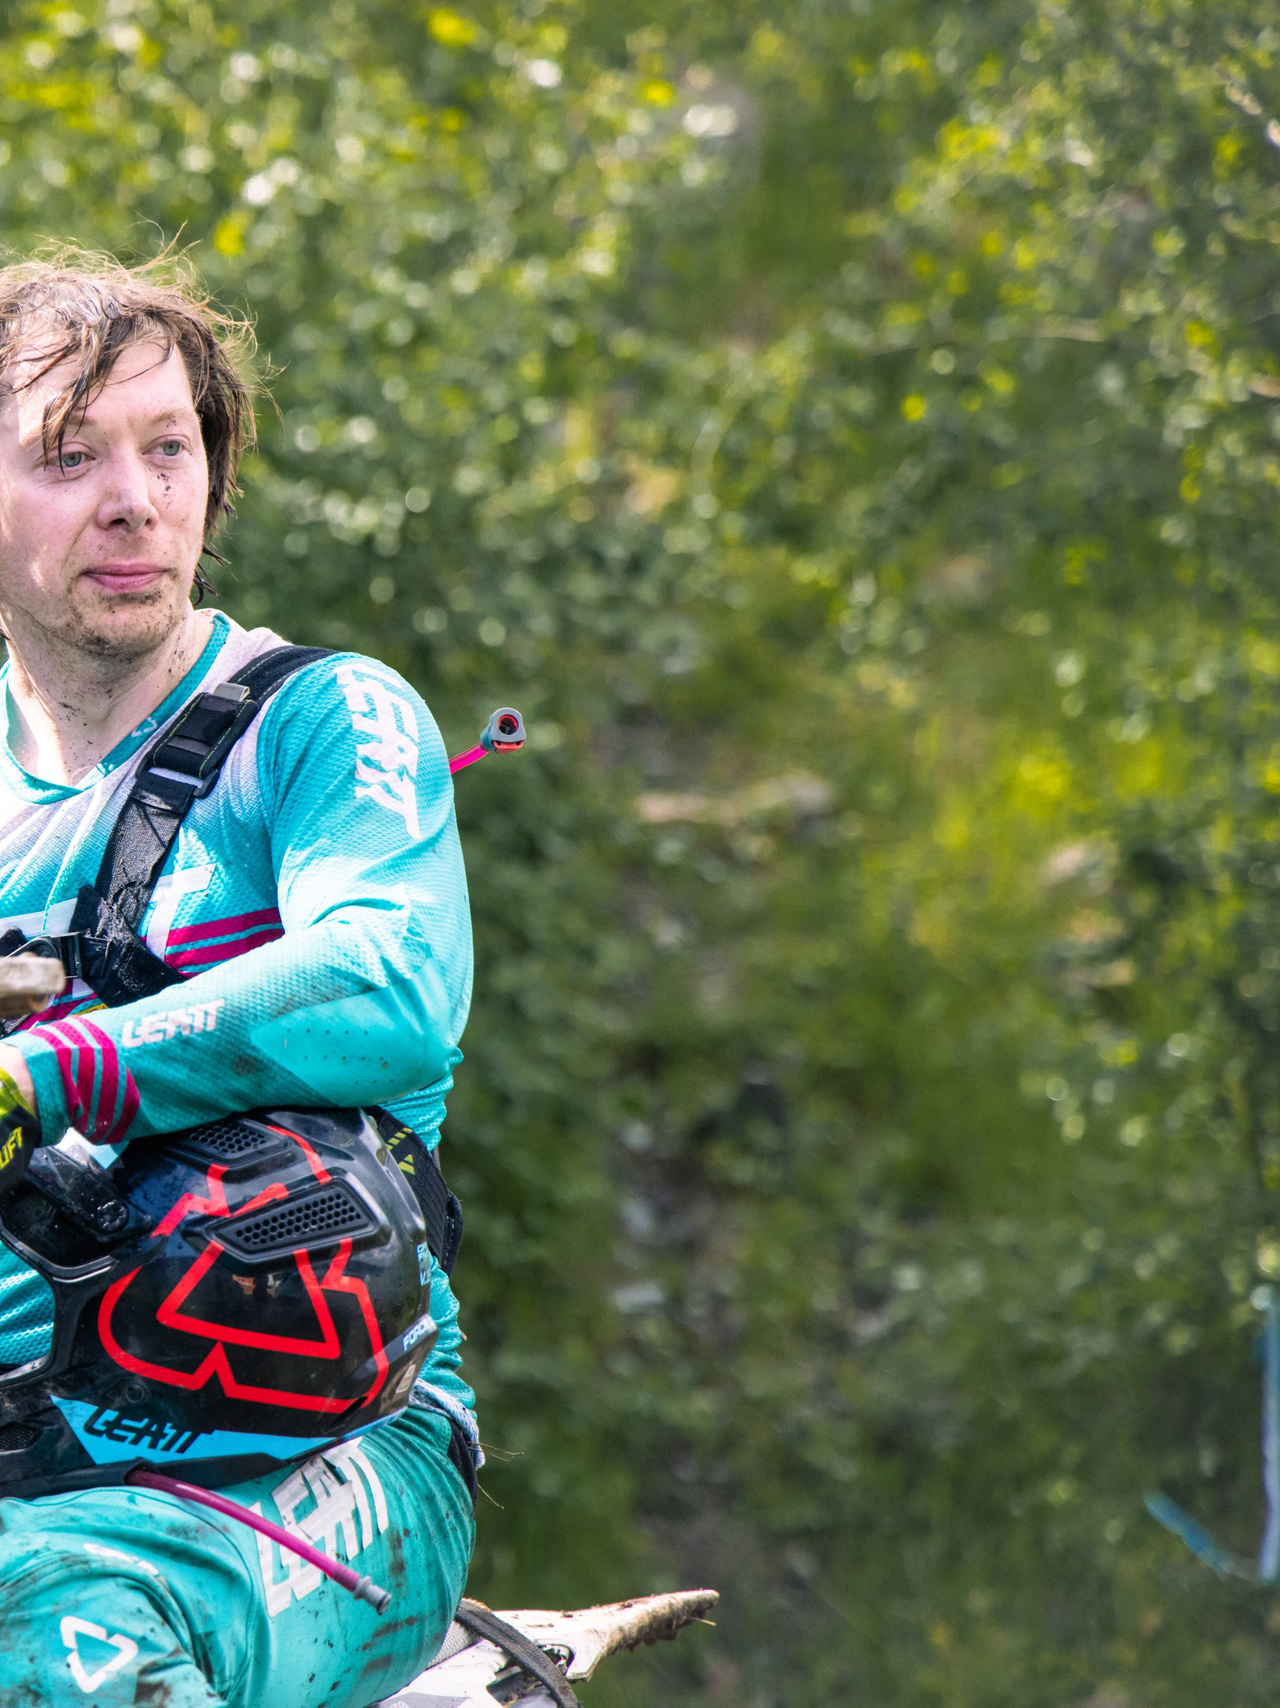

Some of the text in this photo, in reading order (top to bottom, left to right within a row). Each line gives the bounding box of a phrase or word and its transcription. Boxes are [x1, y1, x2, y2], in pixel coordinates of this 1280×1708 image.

[333, 664, 423, 840] LEATT
[121, 998, 225, 1049] LEATT
[83, 1405, 220, 1454] LEATT
[249, 1436, 389, 1618] LEATT
